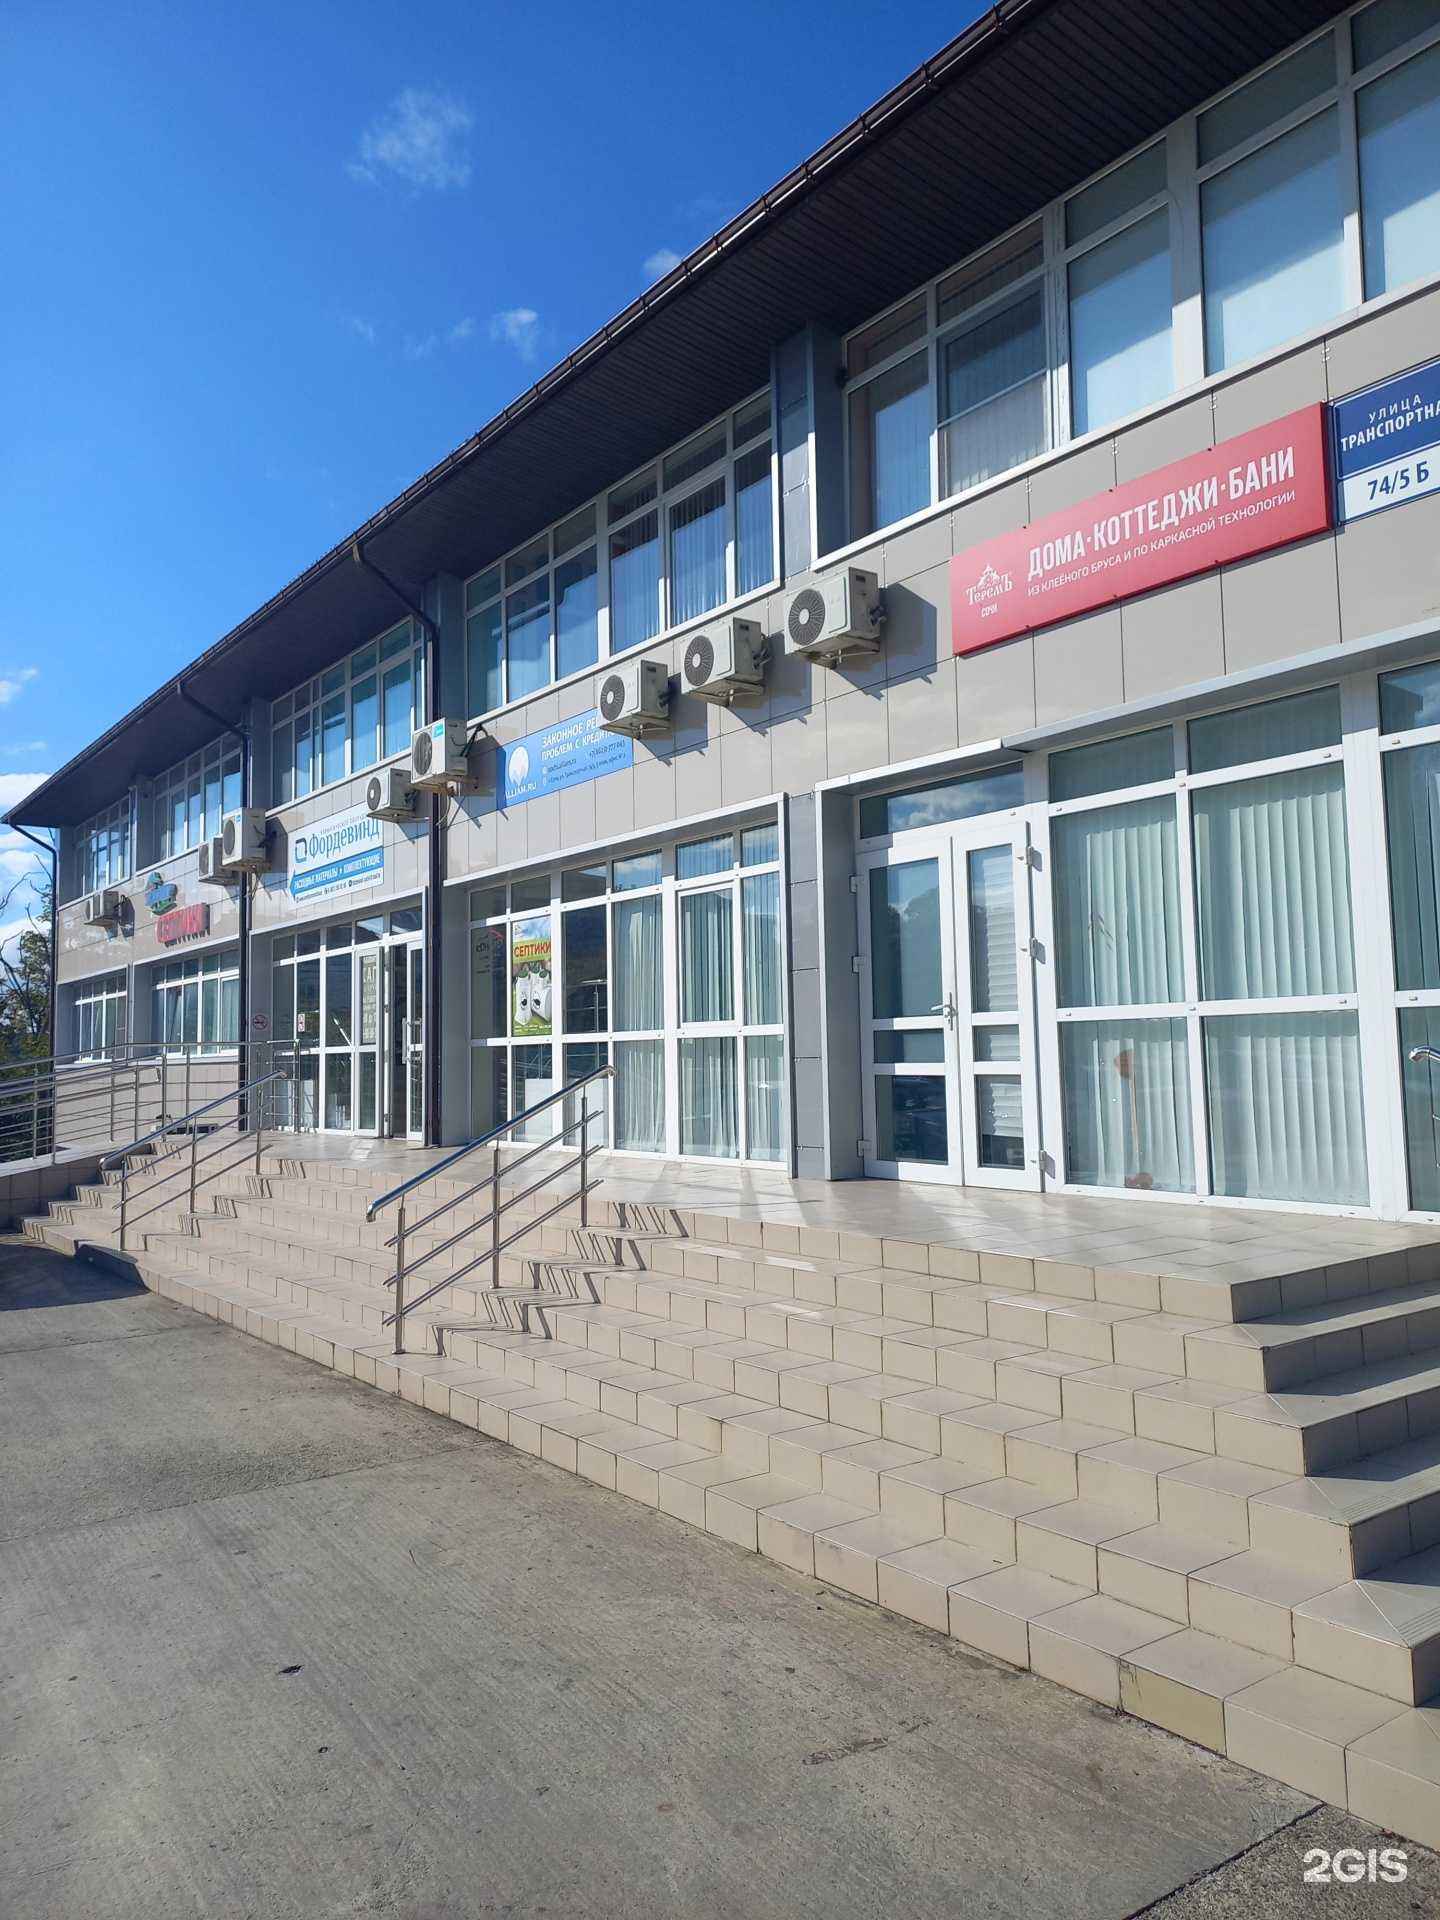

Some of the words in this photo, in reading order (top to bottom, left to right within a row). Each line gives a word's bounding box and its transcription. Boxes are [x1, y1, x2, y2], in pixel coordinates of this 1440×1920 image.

[1369, 394, 1422, 424] УЛИЦА
[1367, 468, 1410, 500] 74/5
[1416, 461, 1429, 483] Б
[1028, 530, 1086, 582] ДОМА
[1094, 476, 1218, 552] КОТТЕДЖИ
[1229, 446, 1295, 500] БАНИ
[1028, 586, 1040, 597] ИЗ
[1091, 555, 1121, 574] БРУСА
[1123, 550, 1132, 562] И
[1133, 545, 1148, 557] ПО
[1150, 518, 1216, 552] КАРКАСНОЙ
[1218, 490, 1296, 526] ТЕХНОЛОГИИ
[541, 742, 573, 761] ПРОБЛЕМ
[575, 738, 582, 749] С
[543, 722, 584, 748] ЗАКОННОЕ
[309, 819, 380, 859] Фордевинд
[513, 942, 551, 958] СЕПТИКИ
